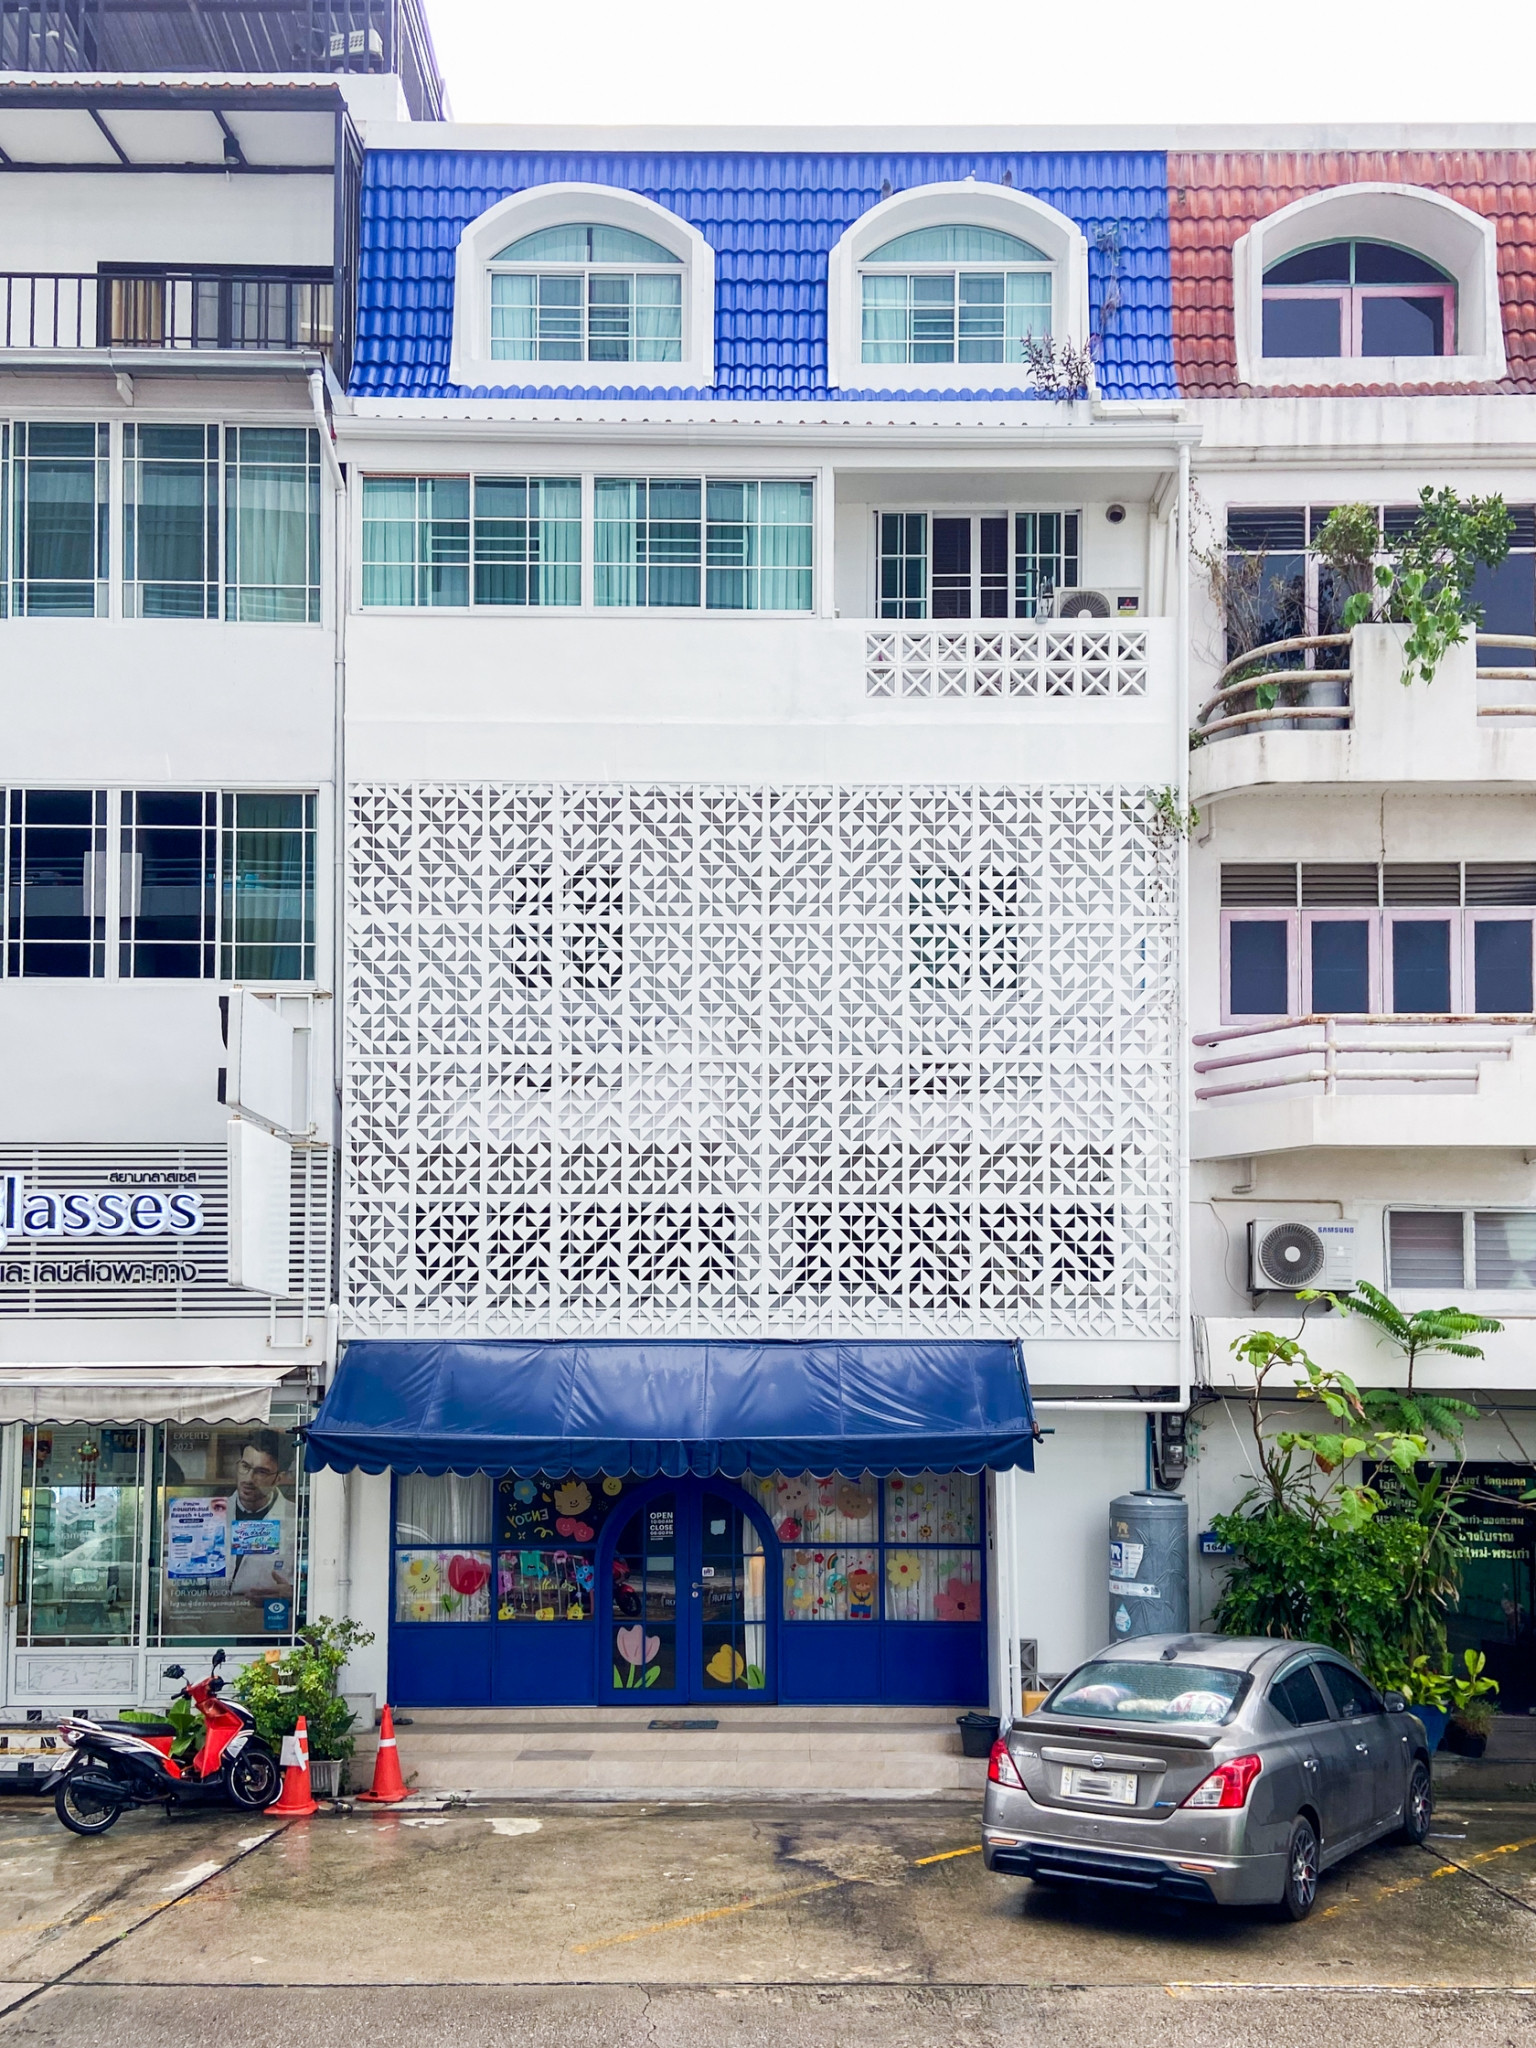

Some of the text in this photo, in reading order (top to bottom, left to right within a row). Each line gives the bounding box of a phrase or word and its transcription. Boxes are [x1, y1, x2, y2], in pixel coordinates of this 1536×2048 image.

[108, 1171, 198, 1185] สยามกลาสเซส
[0, 1174, 201, 1232] lasses
[1317, 1226, 1355, 1234] SAMSUNG
[33, 1259, 198, 1284] เลนส์เฉพาะทาง
[650, 1511, 674, 1520] OPEN
[1205, 1543, 1224, 1551] 164
[187, 1589, 208, 1597] YOUR
[209, 1588, 233, 1597] VISION
